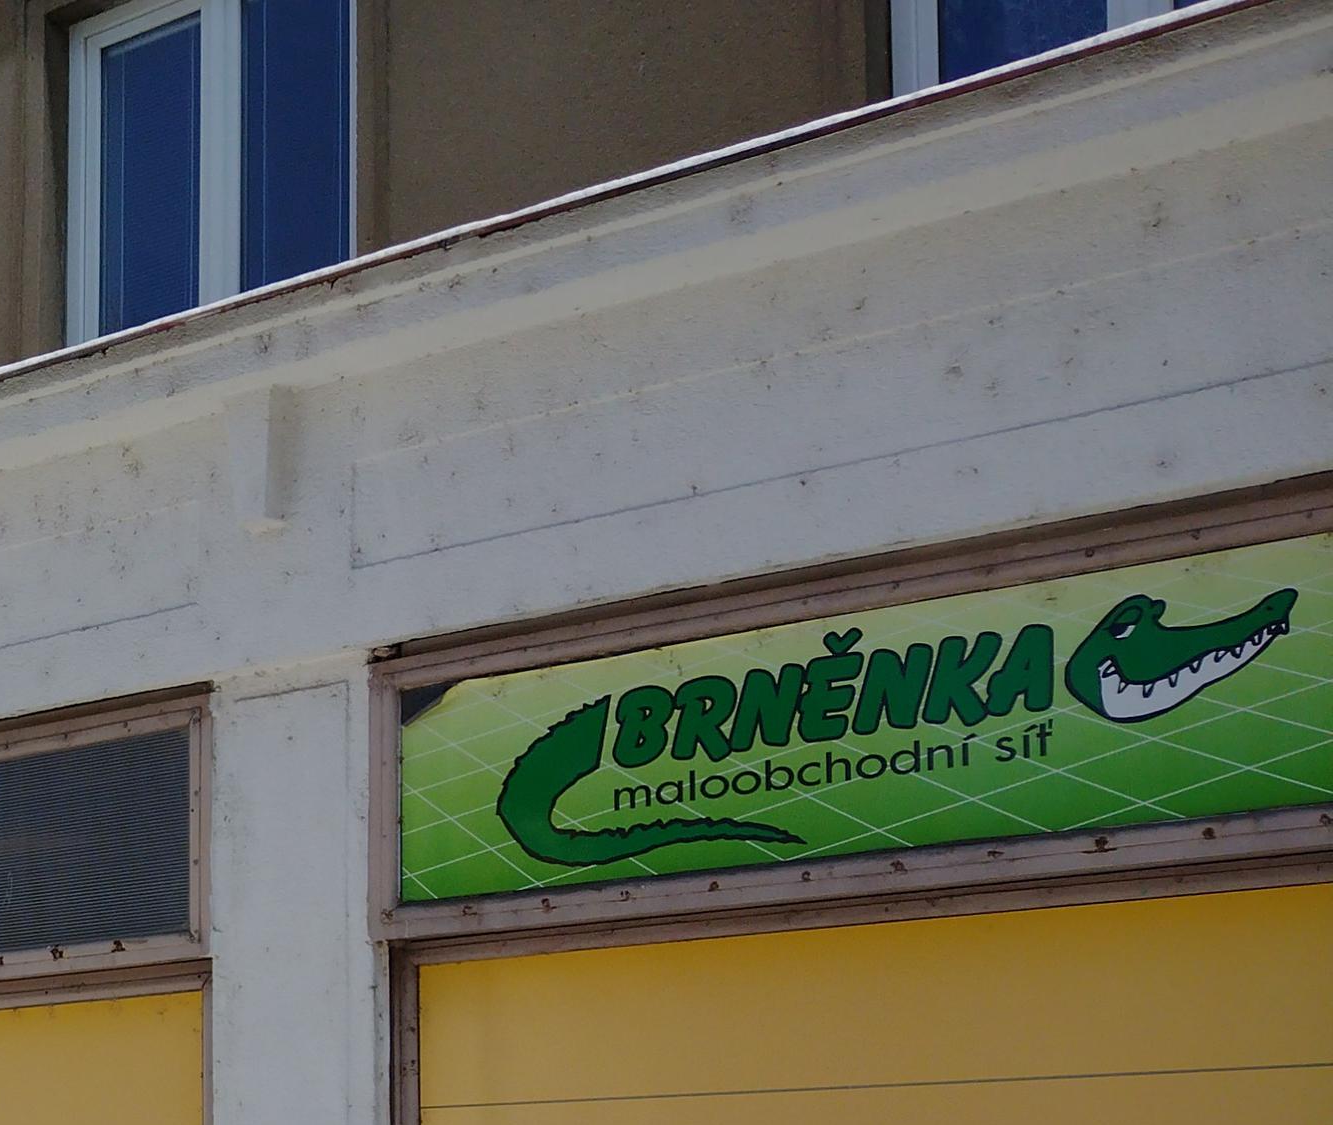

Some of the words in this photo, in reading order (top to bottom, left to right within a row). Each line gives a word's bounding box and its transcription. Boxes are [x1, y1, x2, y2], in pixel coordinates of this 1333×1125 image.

[611, 625, 1054, 768] BRNĚNKA
[612, 732, 978, 812] maloobchodní
[995, 719, 1054, 763] síť
